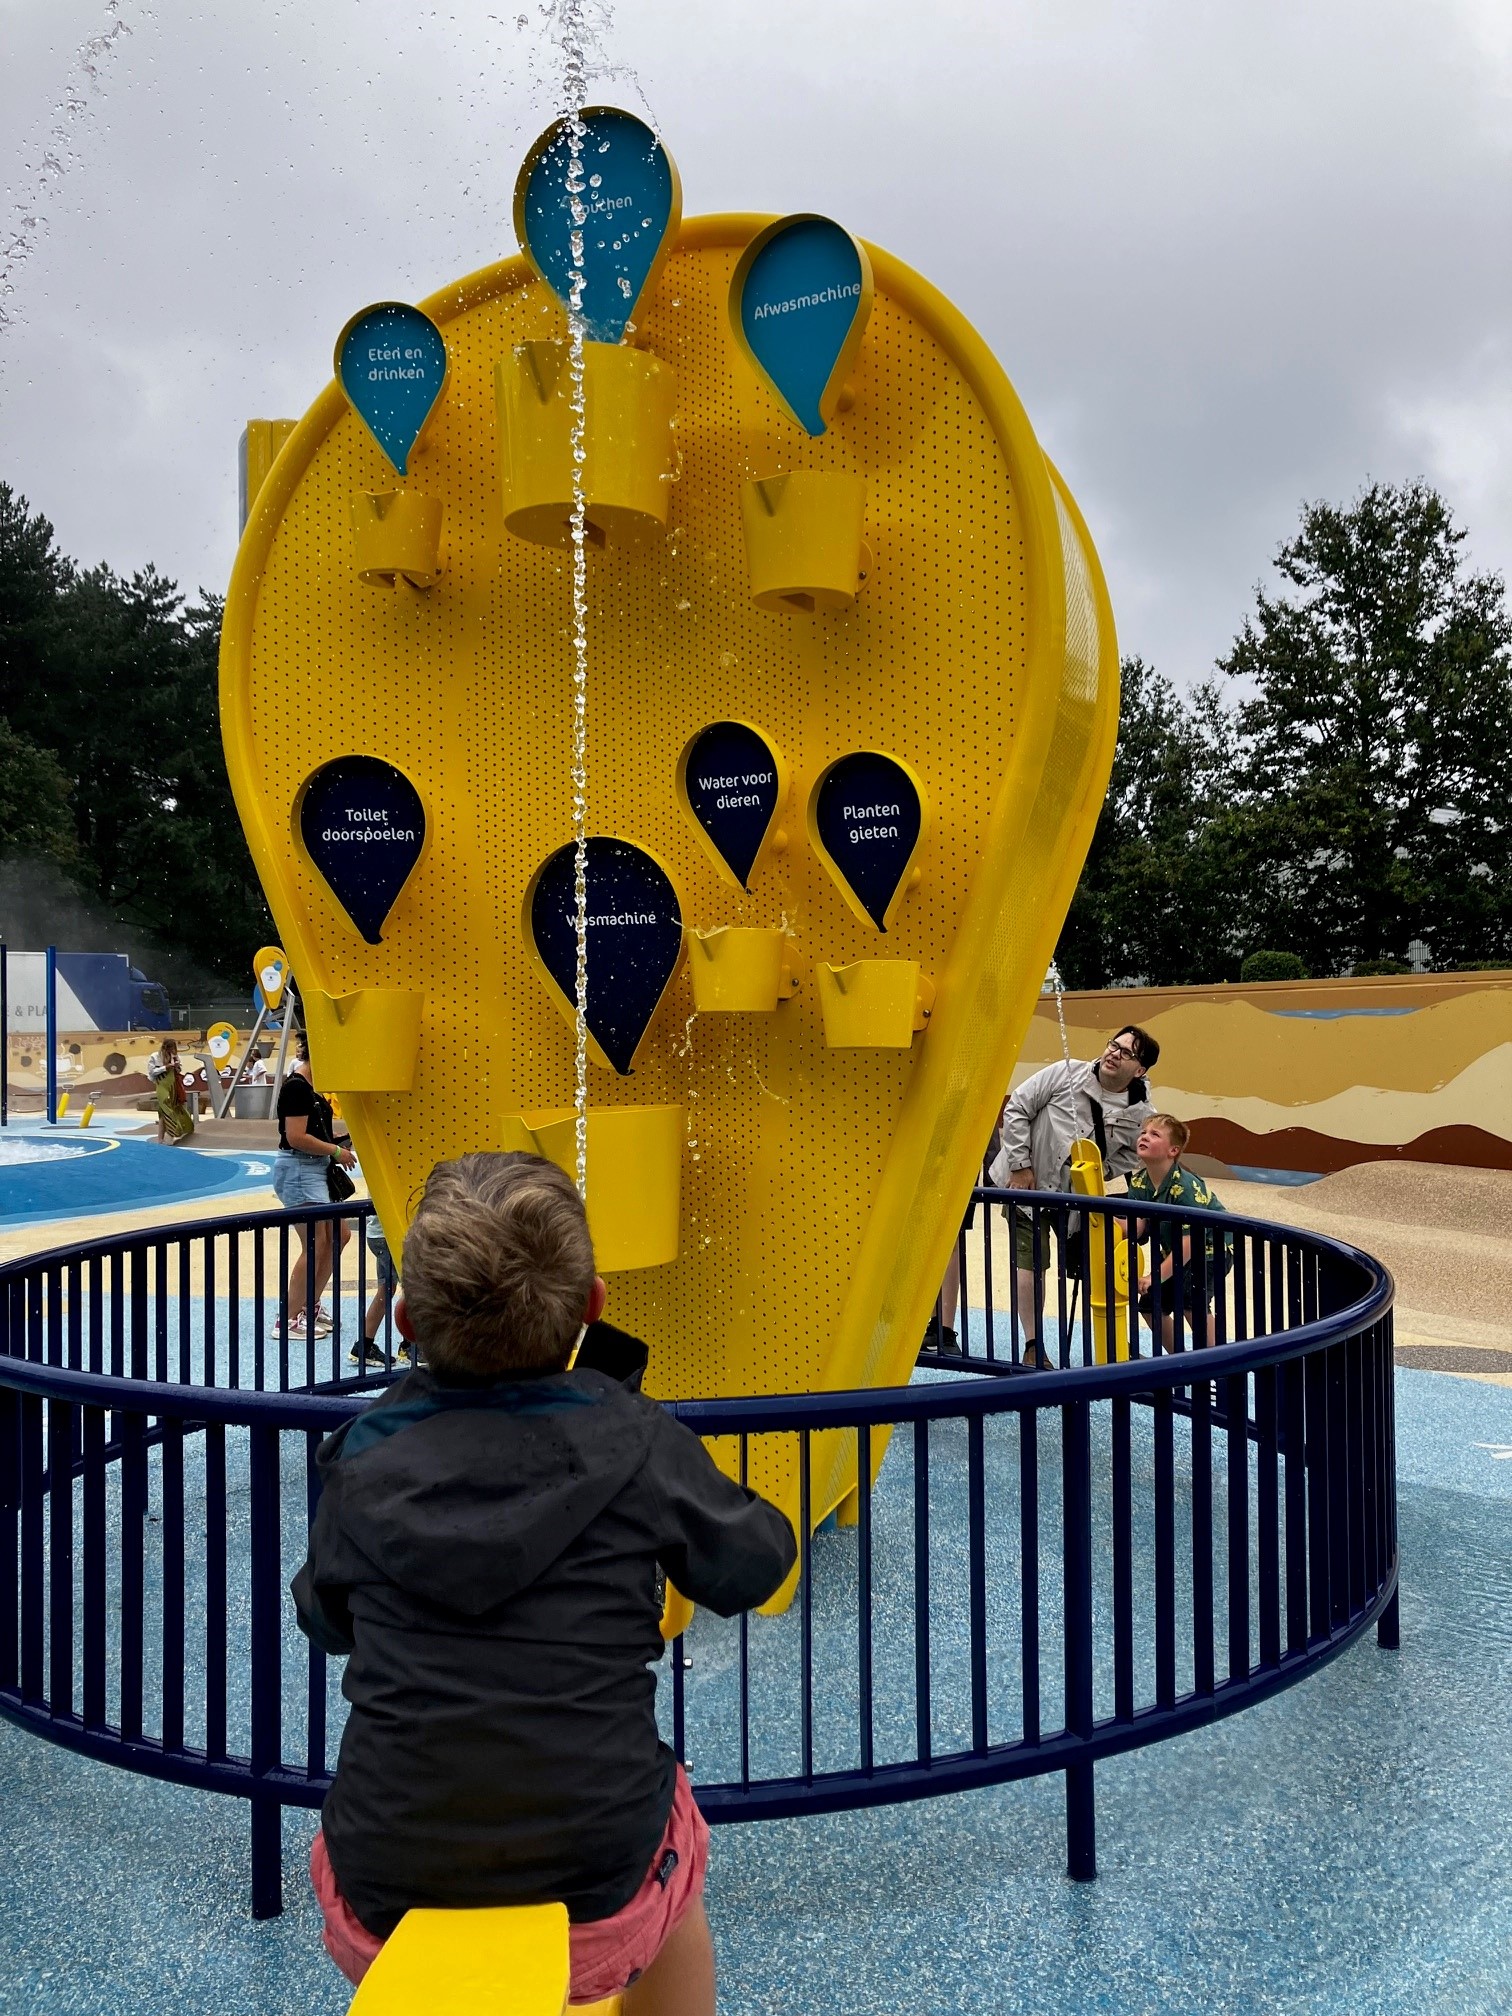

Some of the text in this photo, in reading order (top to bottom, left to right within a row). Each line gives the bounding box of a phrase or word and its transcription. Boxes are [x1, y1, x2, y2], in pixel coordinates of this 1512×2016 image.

[581, 196, 633, 215] ouchen
[754, 283, 861, 320] Afwasmachine
[368, 348, 423, 361] Eten en
[368, 366, 425, 381] drinken
[698, 772, 773, 790] Water voor
[716, 794, 760, 809] dieren
[345, 808, 388, 821] Toilet
[843, 804, 900, 820] Planten
[322, 827, 414, 843] doorspoelen
[849, 826, 898, 843] gieten
[15, 1005, 23, 1017] &
[27, 1005, 48, 1017] PLA
